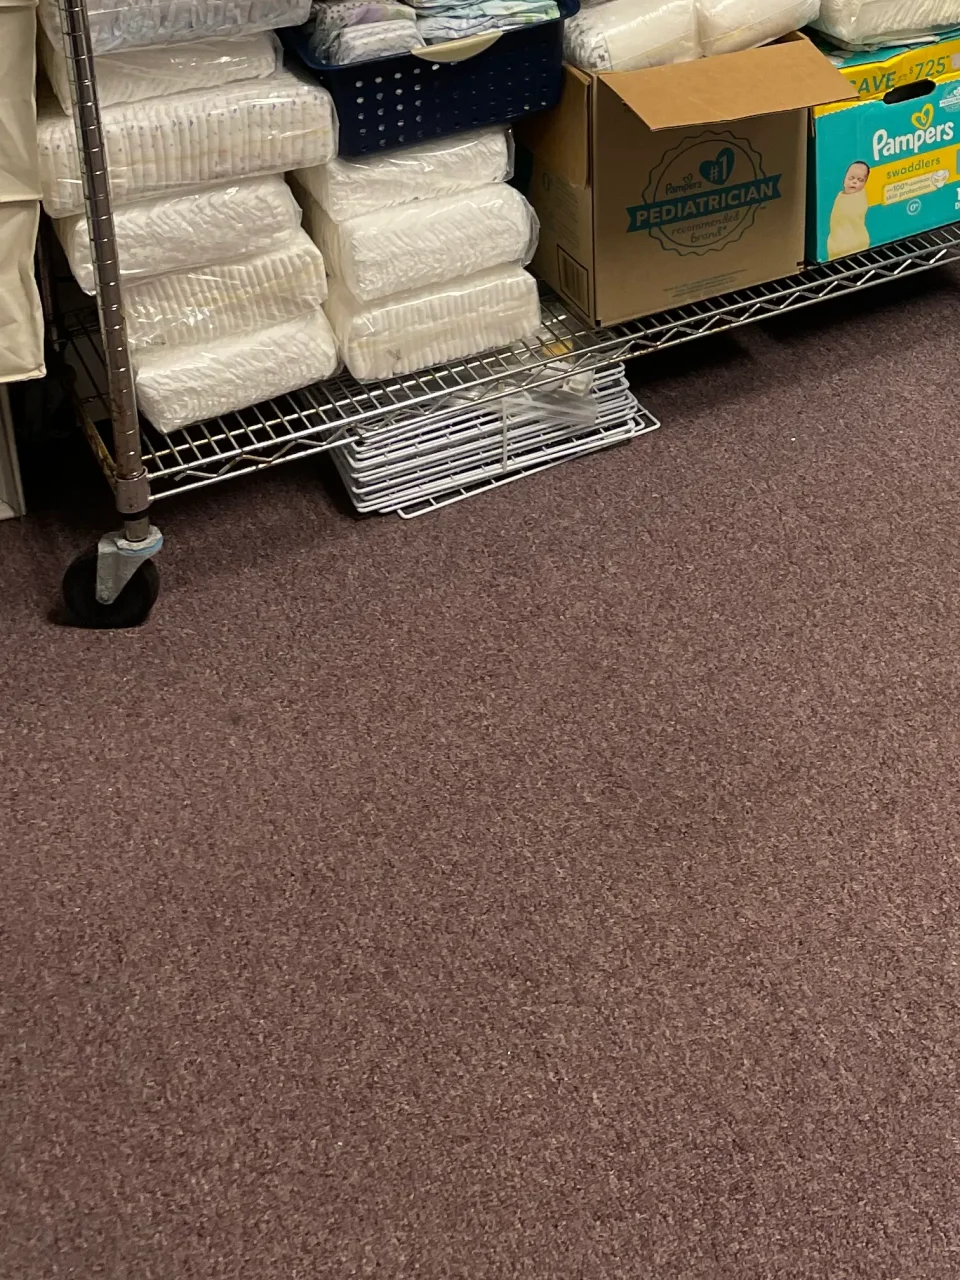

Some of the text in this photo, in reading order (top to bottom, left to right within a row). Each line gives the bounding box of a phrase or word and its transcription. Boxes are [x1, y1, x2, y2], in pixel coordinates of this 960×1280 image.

[850, 71, 897, 94] AVE
[872, 121, 955, 161] Pampers
[665, 154, 728, 197] Pampers #1
[886, 157, 942, 180] swaddlers
[635, 181, 774, 227] PEDIATRICIAN
[671, 210, 741, 236] recommended
